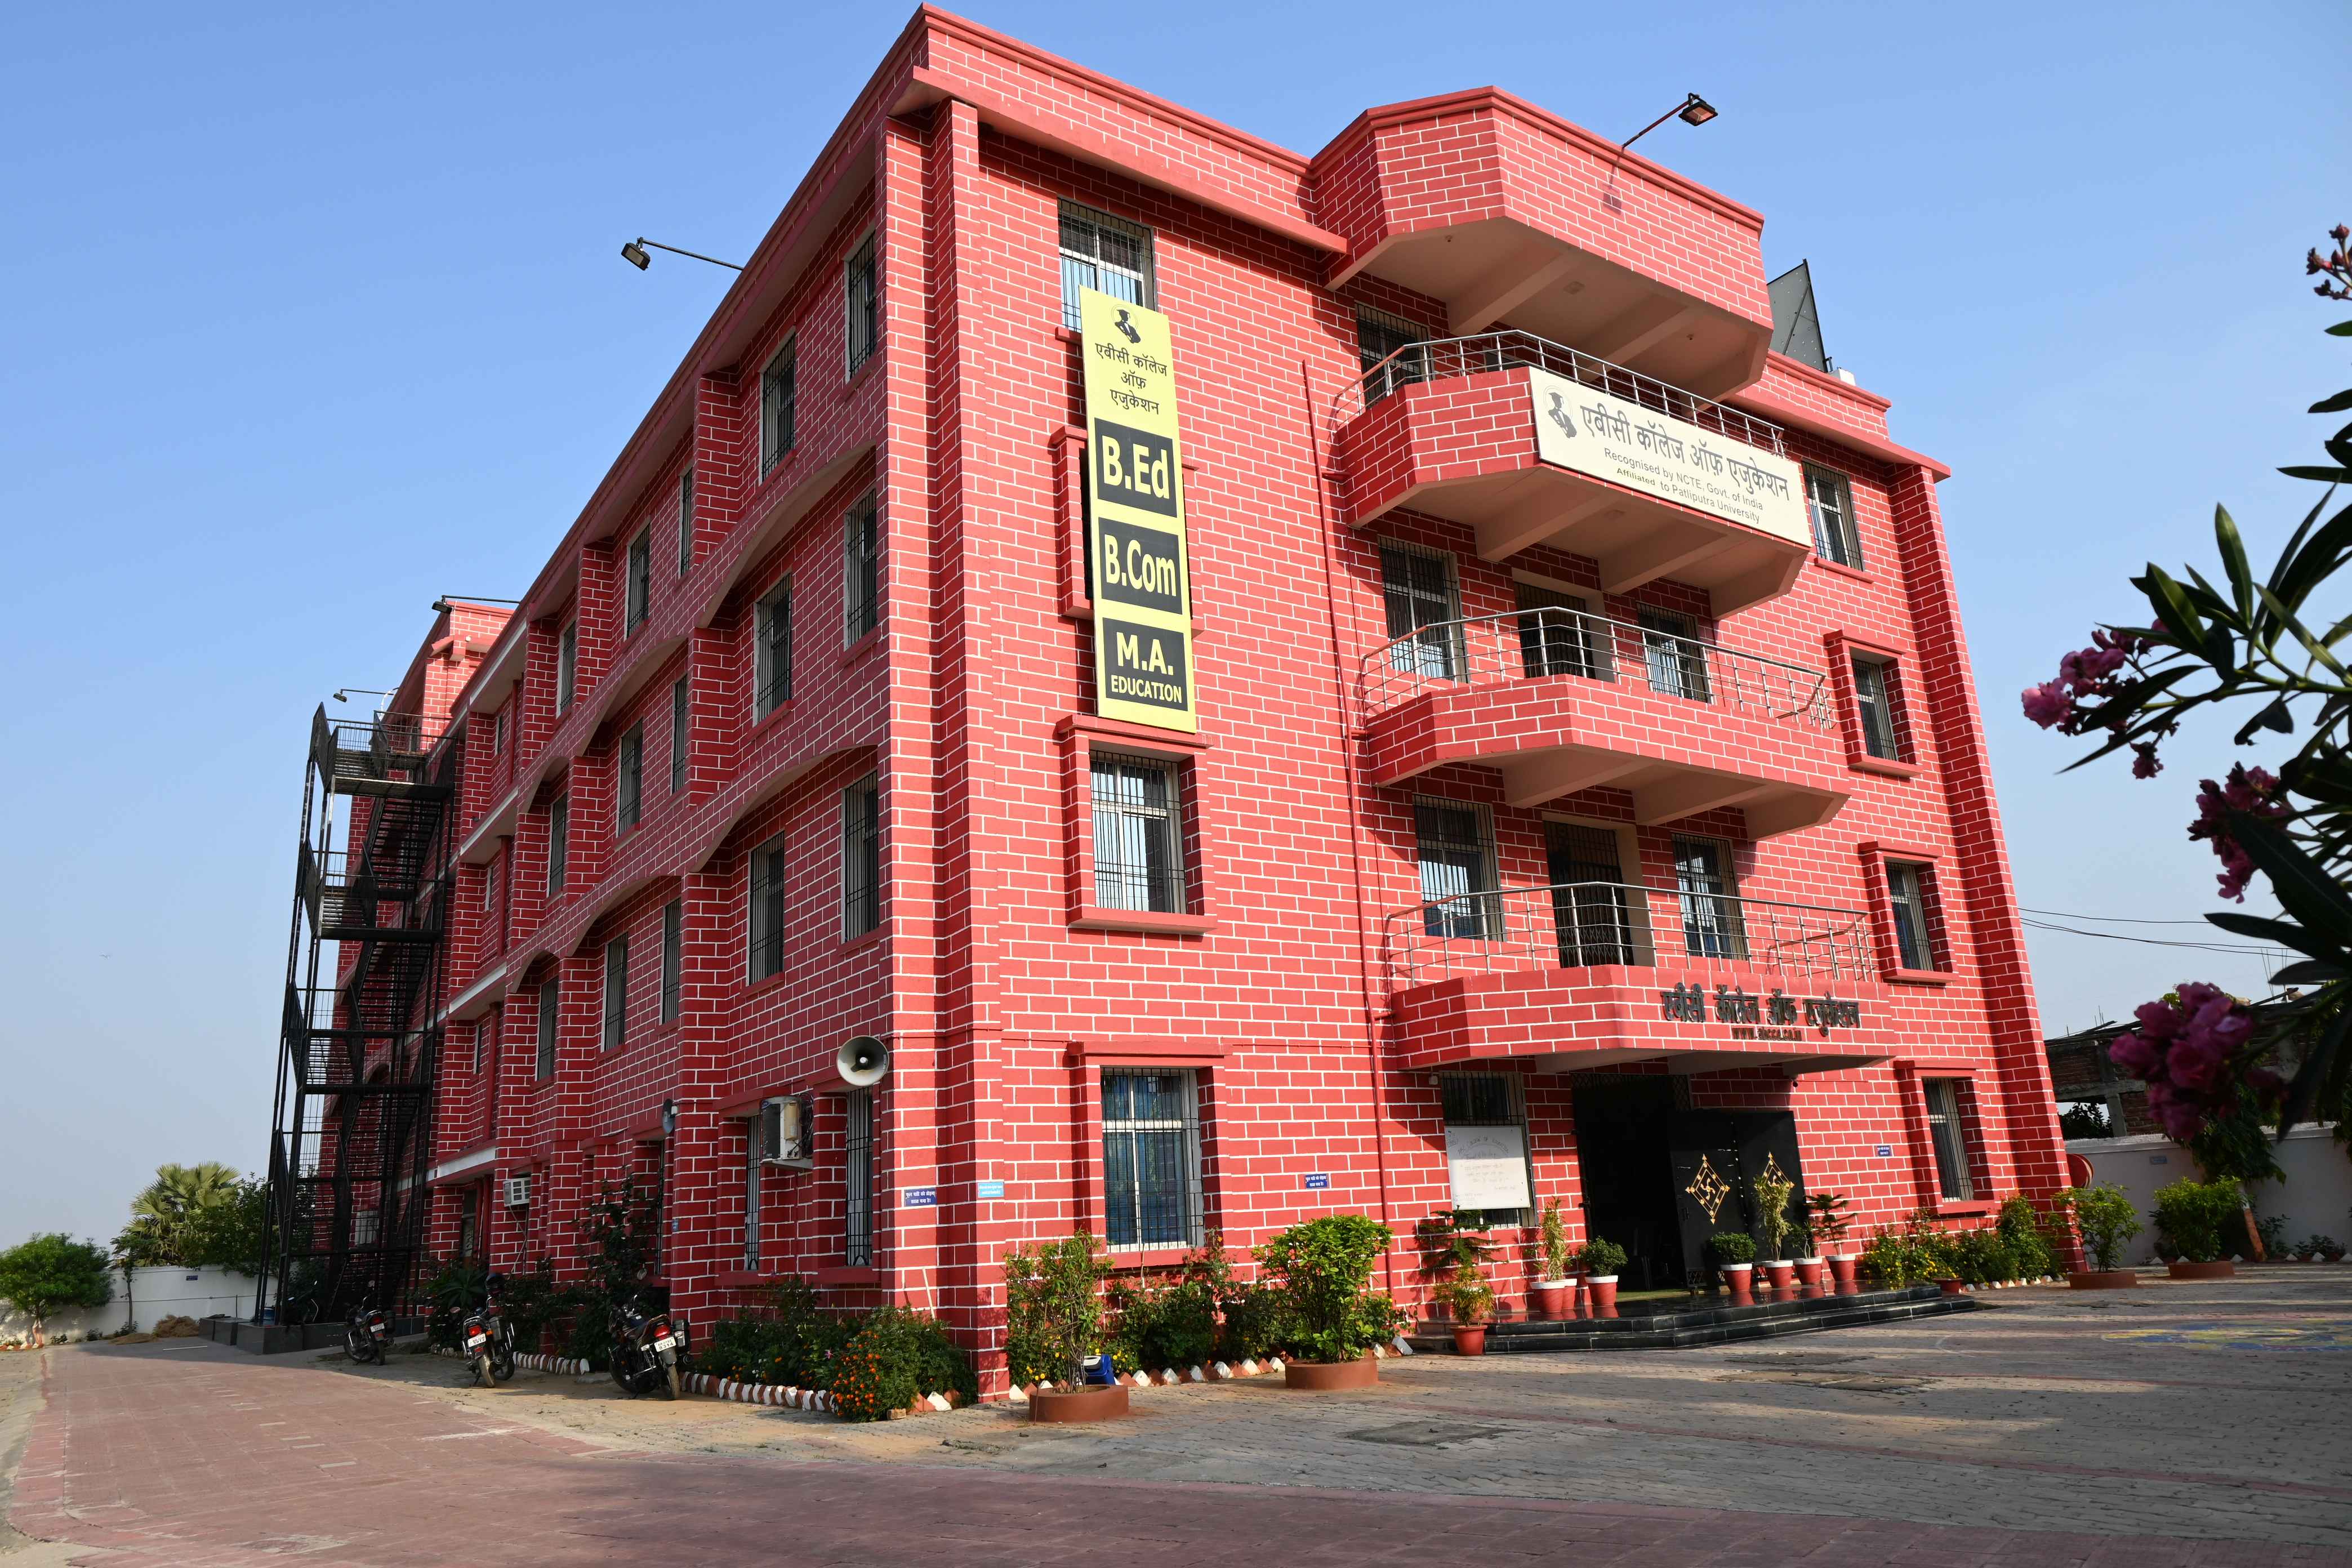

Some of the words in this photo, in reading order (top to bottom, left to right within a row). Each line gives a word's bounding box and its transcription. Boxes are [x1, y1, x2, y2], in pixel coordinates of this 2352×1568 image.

[1094, 342, 1130, 365] एबीसी
[1132, 353, 1168, 376] कॉलेज
[1120, 369, 1147, 389] ऑफ़
[1110, 389, 1160, 415] एजुकेशन
[1101, 436, 1170, 500] B.Ed
[1580, 402, 1632, 445] एबीसी
[1634, 420, 1685, 464] कॉलेज
[1690, 438, 1723, 476] ऑफ़
[1726, 456, 1789, 501] एजुकेशन
[1604, 447, 1660, 474] Recognised
[1663, 467, 1673, 482] by
[1677, 472, 1705, 492] NCTE,
[1707, 483, 1730, 499] Govt.
[1732, 493, 1740, 502] of
[1743, 495, 1763, 510] India
[1616, 468, 1655, 485] Affiliated
[1660, 481, 1669, 492] to
[1673, 485, 1716, 507] Patliputra
[1717, 500, 1759, 524] University
[1105, 533, 1177, 598] B.Com
[1116, 631, 1174, 676] M.A.
[1111, 673, 1182, 703] EDUCATION
[1660, 982, 1706, 1023] एबीसी
[1713, 984, 1761, 1024] कॉलेज
[1803, 991, 1860, 1037] एजुकेशन
